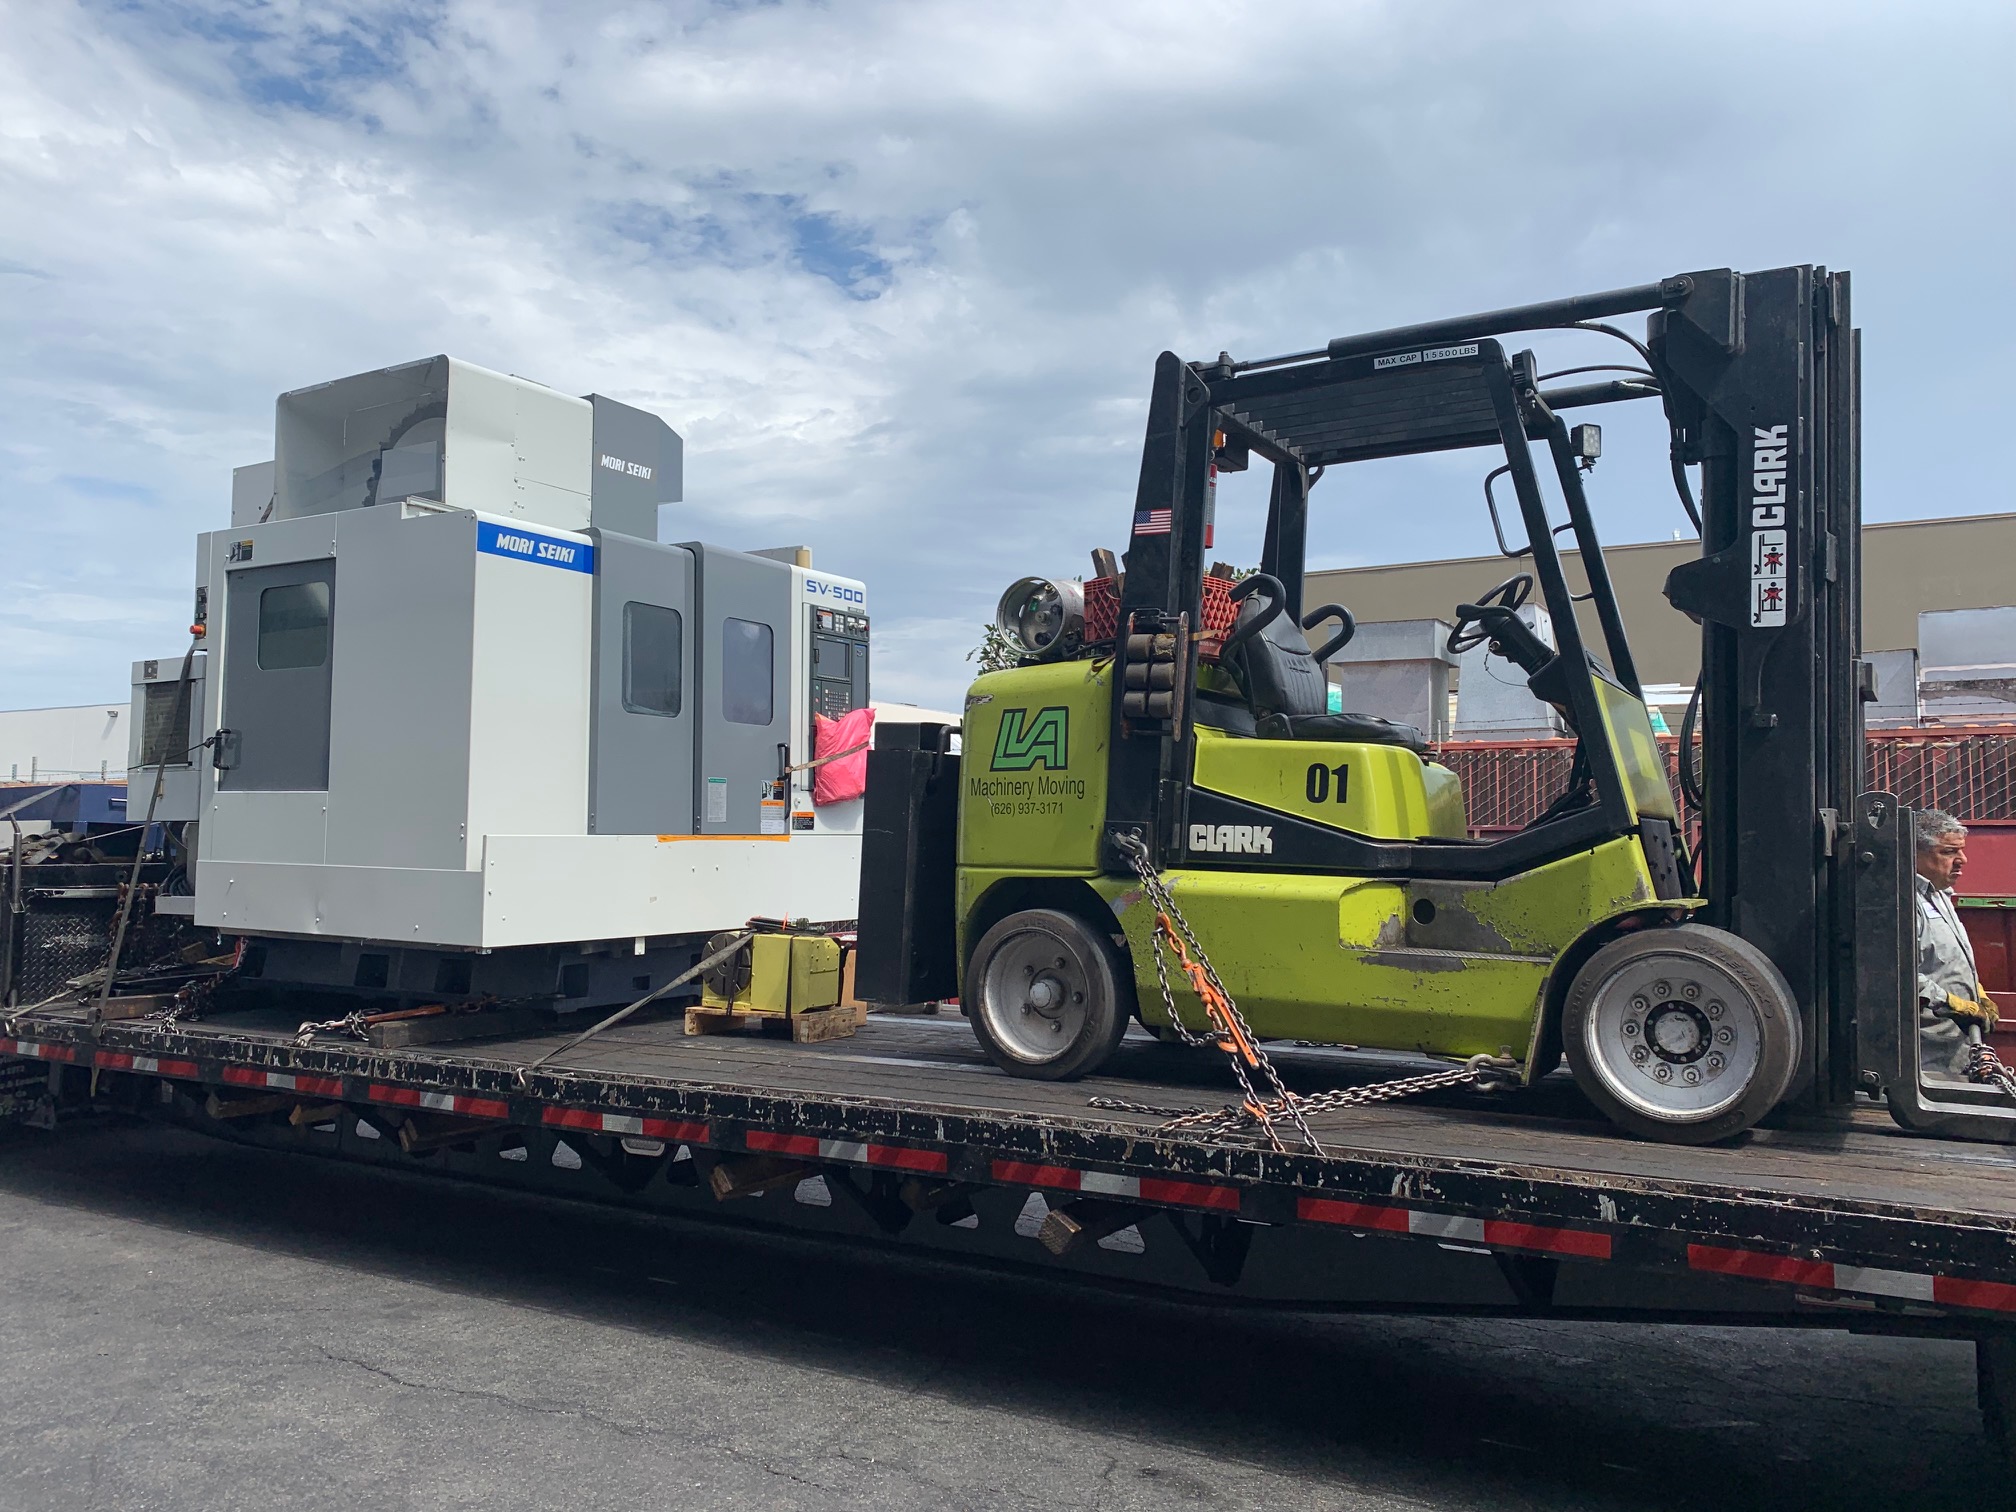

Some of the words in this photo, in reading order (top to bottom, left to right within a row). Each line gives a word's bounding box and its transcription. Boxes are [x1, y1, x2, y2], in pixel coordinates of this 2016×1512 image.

[1378, 357, 1397, 367] MAX
[1400, 353, 1417, 363] CAP
[601, 454, 626, 472] MORI
[626, 462, 652, 480] SEIKI
[1752, 424, 1788, 527] CLARK
[496, 533, 535, 555] MORI
[537, 542, 576, 564] SEIKI
[806, 579, 863, 604] SV-500
[970, 777, 1034, 800] Machinery
[1038, 775, 1085, 800] Moving
[1306, 762, 1349, 804] 01
[991, 802, 1016, 817] (626)
[1018, 801, 1063, 815] 937-3171
[1189, 824, 1274, 854] CLARK
